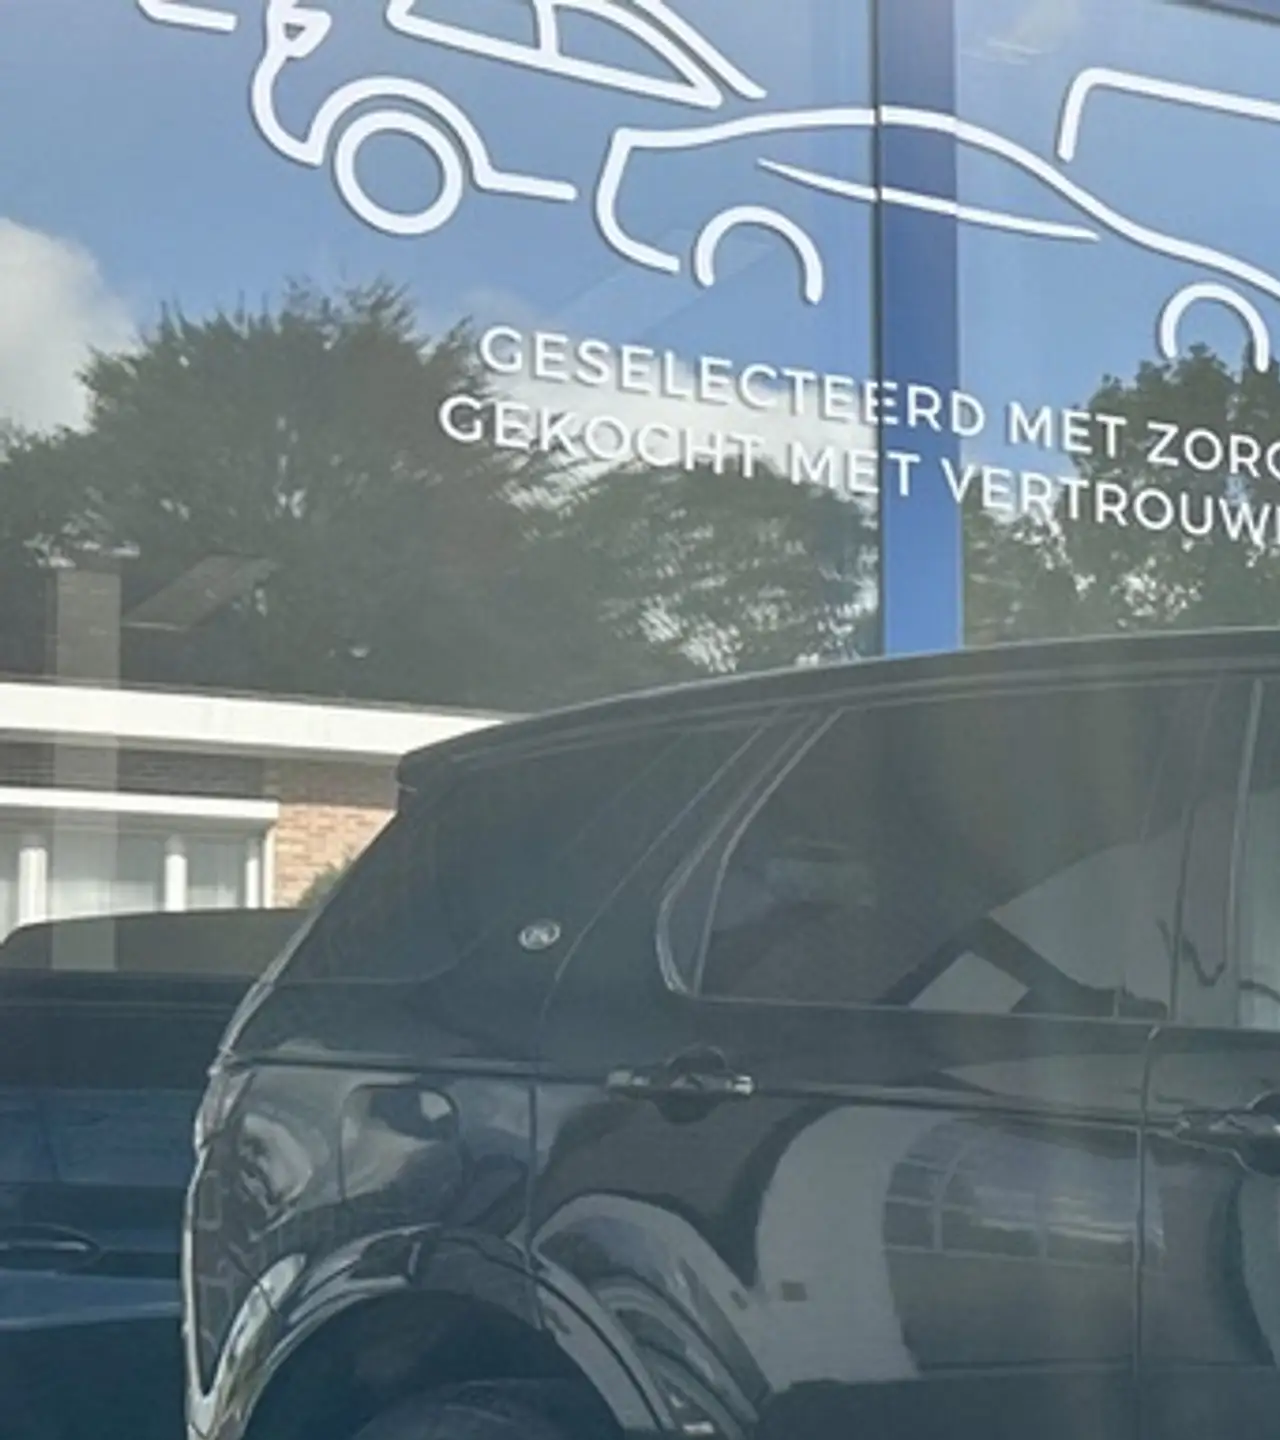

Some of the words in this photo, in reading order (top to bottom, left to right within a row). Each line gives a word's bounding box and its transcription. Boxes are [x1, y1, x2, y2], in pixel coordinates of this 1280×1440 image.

[438, 394, 763, 479] GEKOCHT
[790, 441, 921, 497] MET
[479, 325, 986, 437] GESELECTEERD
[1008, 401, 1128, 458] MET
